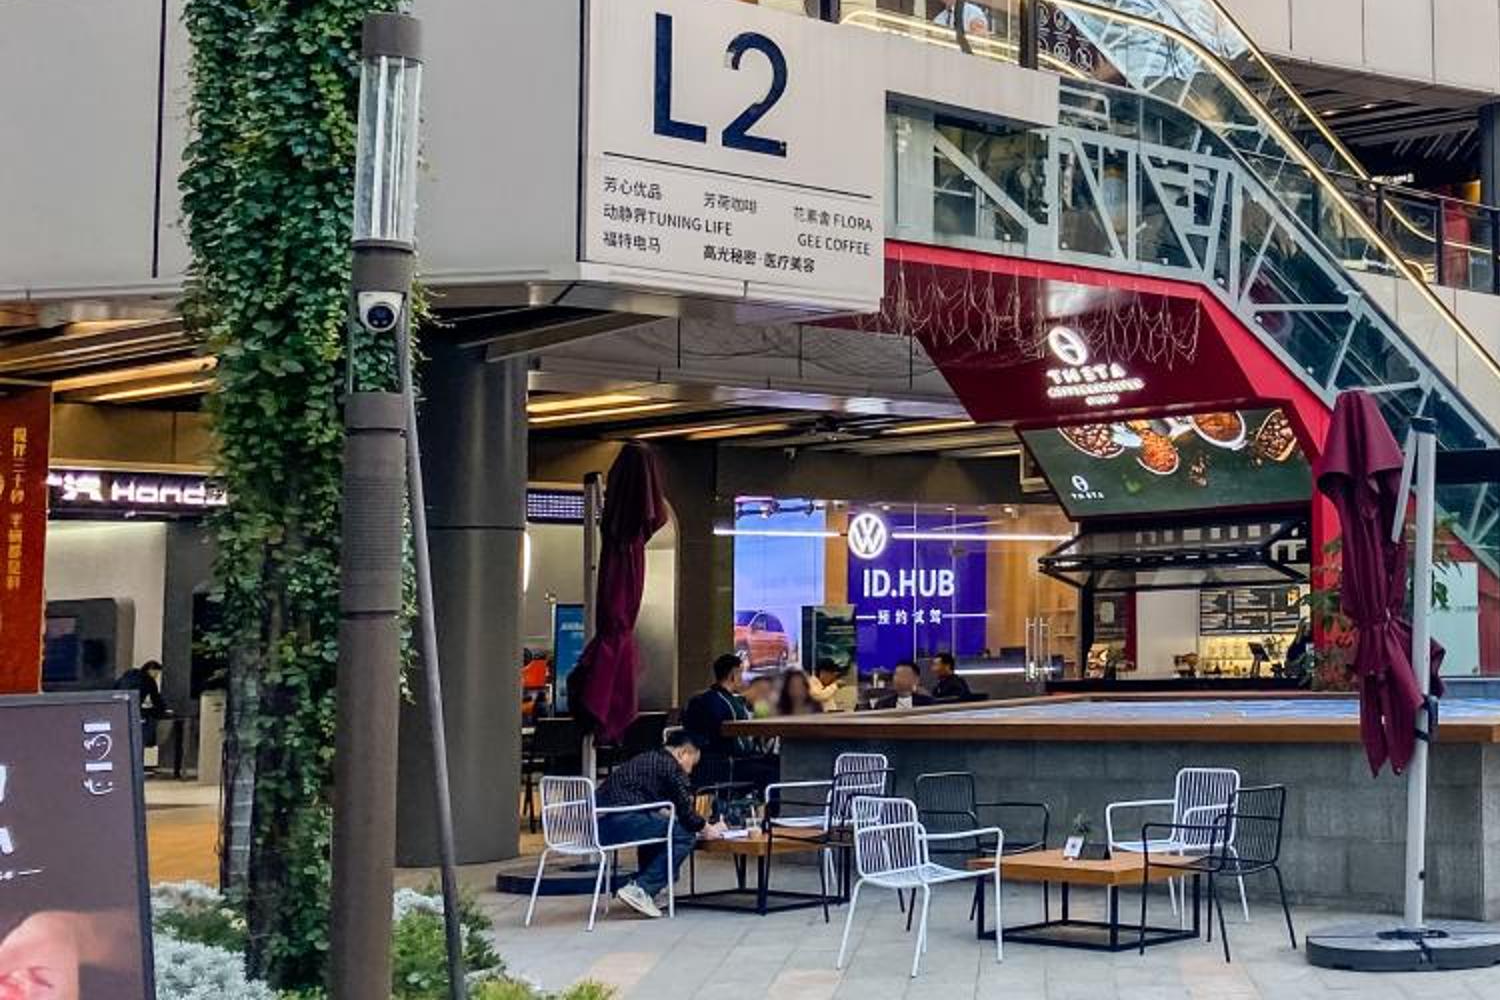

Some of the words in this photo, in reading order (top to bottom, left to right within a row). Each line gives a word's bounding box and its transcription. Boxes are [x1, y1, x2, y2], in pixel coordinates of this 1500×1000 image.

[653, 12, 788, 157] L2
[603, 176, 662, 200] 芳心优品
[704, 220, 733, 236] LIFE
[833, 214, 873, 232] FLORA
[797, 233, 821, 249] GEE
[825, 237, 871, 256] COFFEE
[863, 569, 955, 597] ID.HUB
